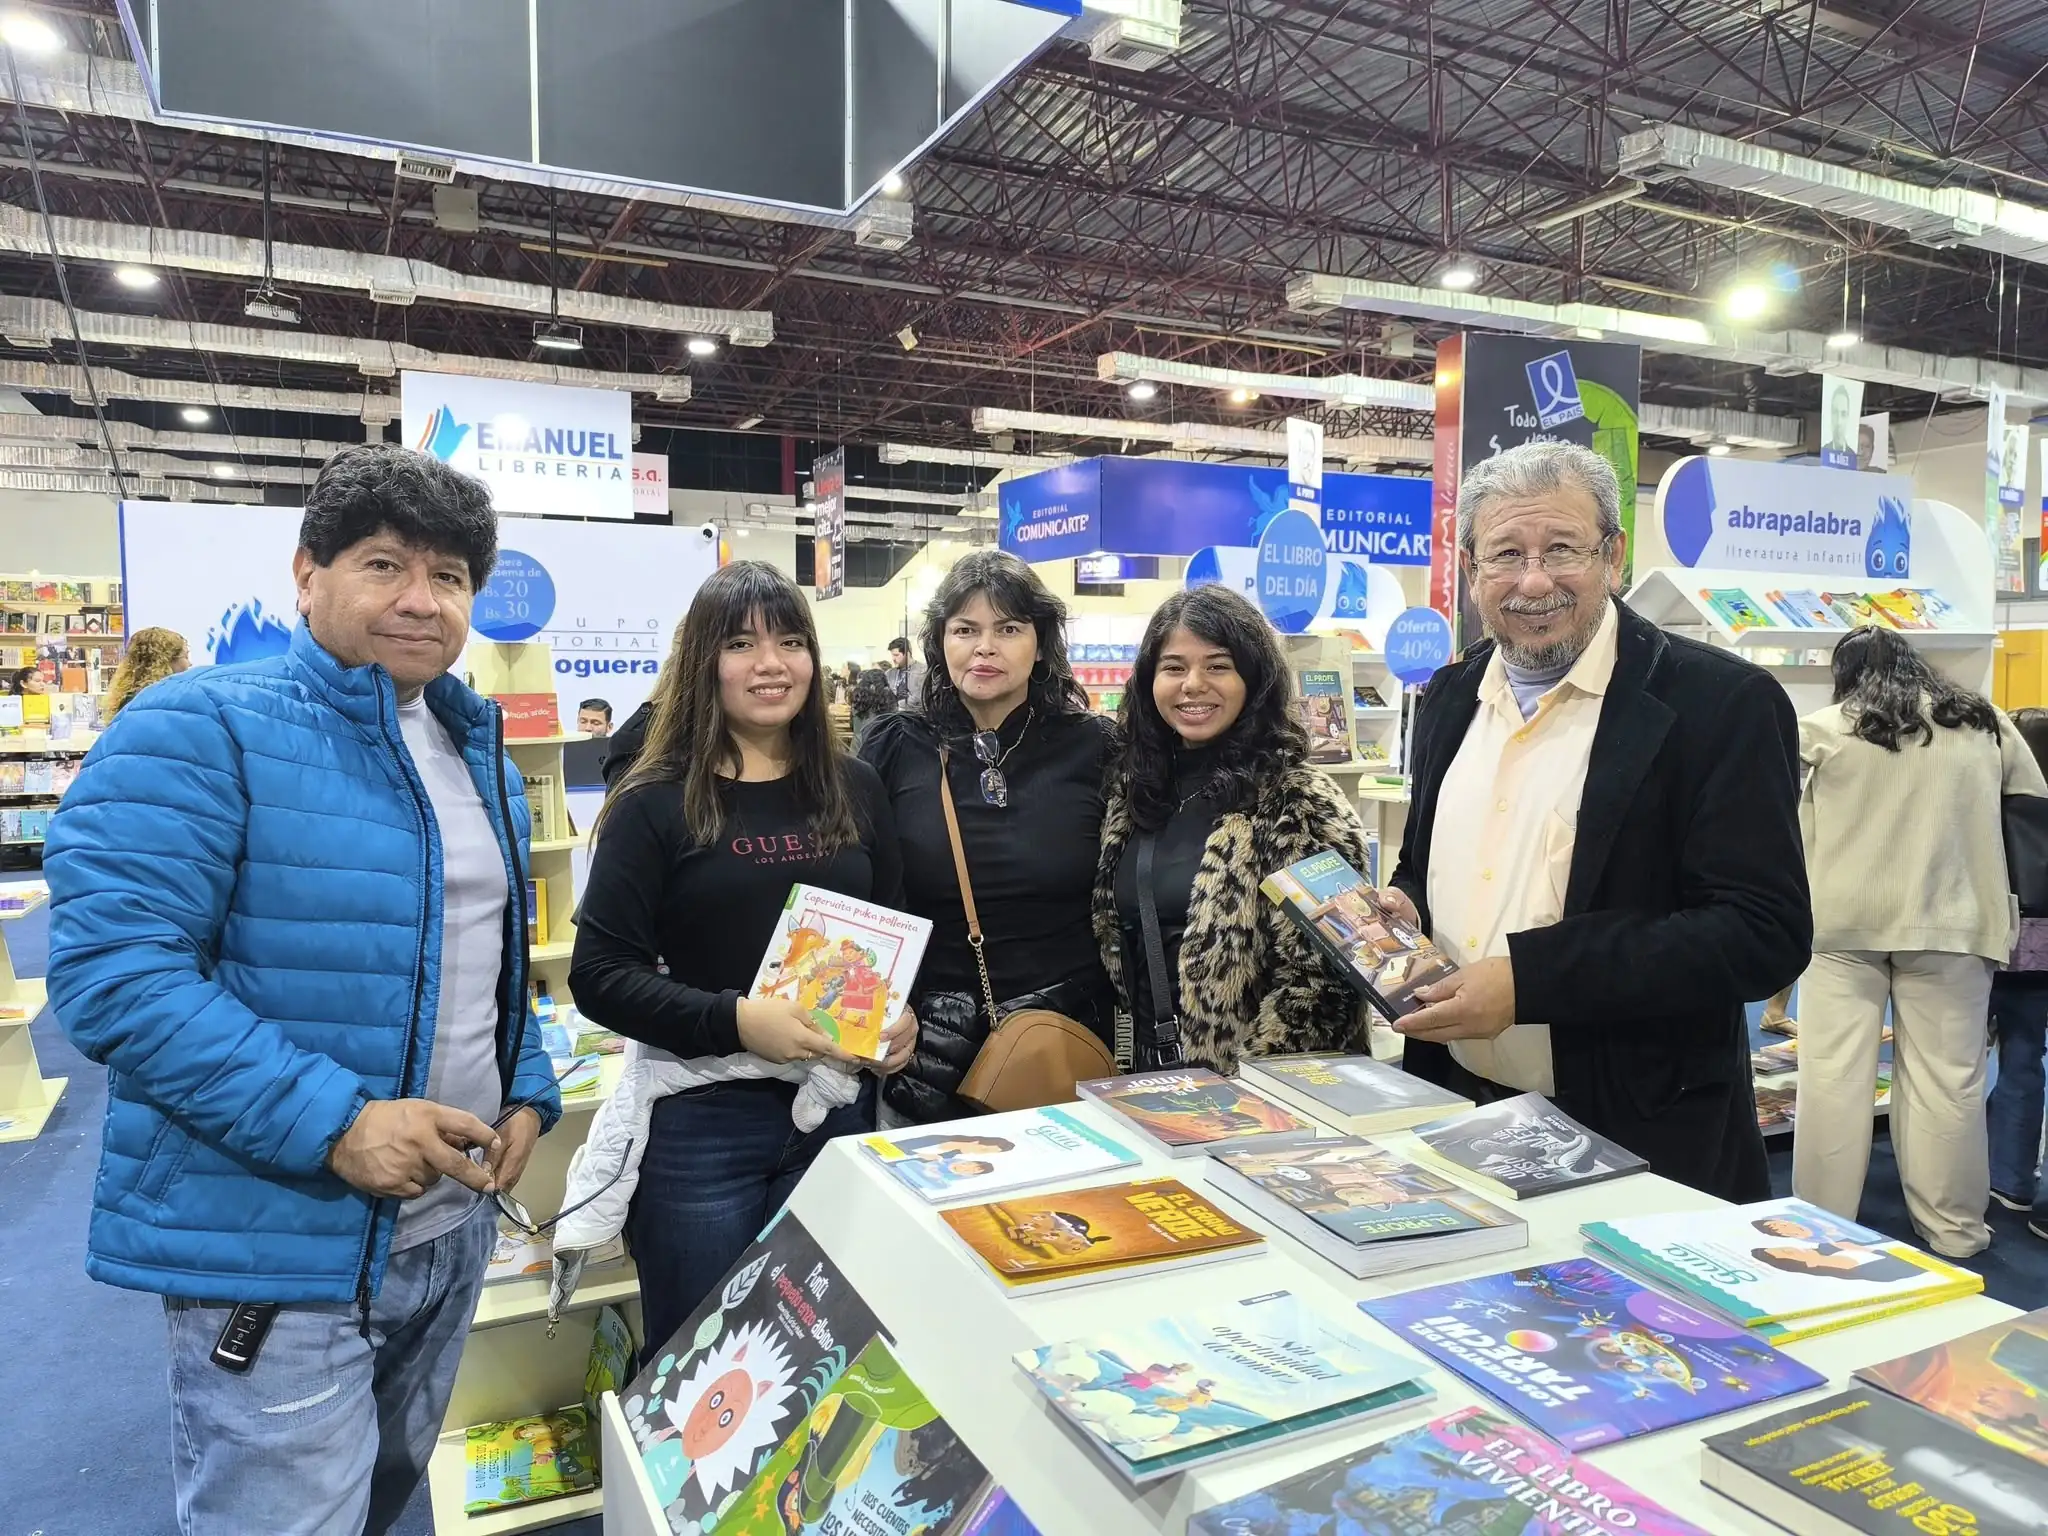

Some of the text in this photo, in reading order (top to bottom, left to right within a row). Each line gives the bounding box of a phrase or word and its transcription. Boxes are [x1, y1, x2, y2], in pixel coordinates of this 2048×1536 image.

[1504, 405, 1537, 427] Todo
[1543, 406, 1584, 428] EL PAIS
[479, 457, 623, 480] LIBRERIA
[1032, 504, 1069, 519] EDITORIAL
[1326, 509, 1413, 526] EDITORIAL
[1728, 505, 1861, 537] abrapalabra
[1017, 514, 1088, 542] COMUNICARTE
[1264, 543, 1323, 567] EL LIBRO
[1726, 544, 1862, 565] literatura infantil
[484, 579, 529, 598] Bs 20
[1265, 575, 1318, 598] DEL DÍA
[485, 600, 530, 619] Bs 30
[1397, 620, 1440, 633] Oferta
[1391, 640, 1442, 660] -40%
[555, 658, 659, 678] oguera
[755, 857, 774, 865] LOS
[853, 906, 878, 921] puka
[879, 914, 918, 932] pollerita
[1166, 1193, 1195, 1207] EL
[1360, 1219, 1434, 1234] PROFE
[1435, 1217, 1461, 1226] EL
[770, 1263, 787, 1281] el
[811, 1317, 834, 1351] albino
[1202, 1341, 1235, 1354] de
[1212, 1326, 1342, 1380] oportunidad
[1281, 1340, 1316, 1356] Sin
[1422, 1315, 1594, 1401] TARECHI
[1407, 1322, 1564, 1408] LOS CUENTOS DEL
[1484, 1438, 1637, 1528] EL LIBRO
[876, 1503, 910, 1536] CUENTOS
